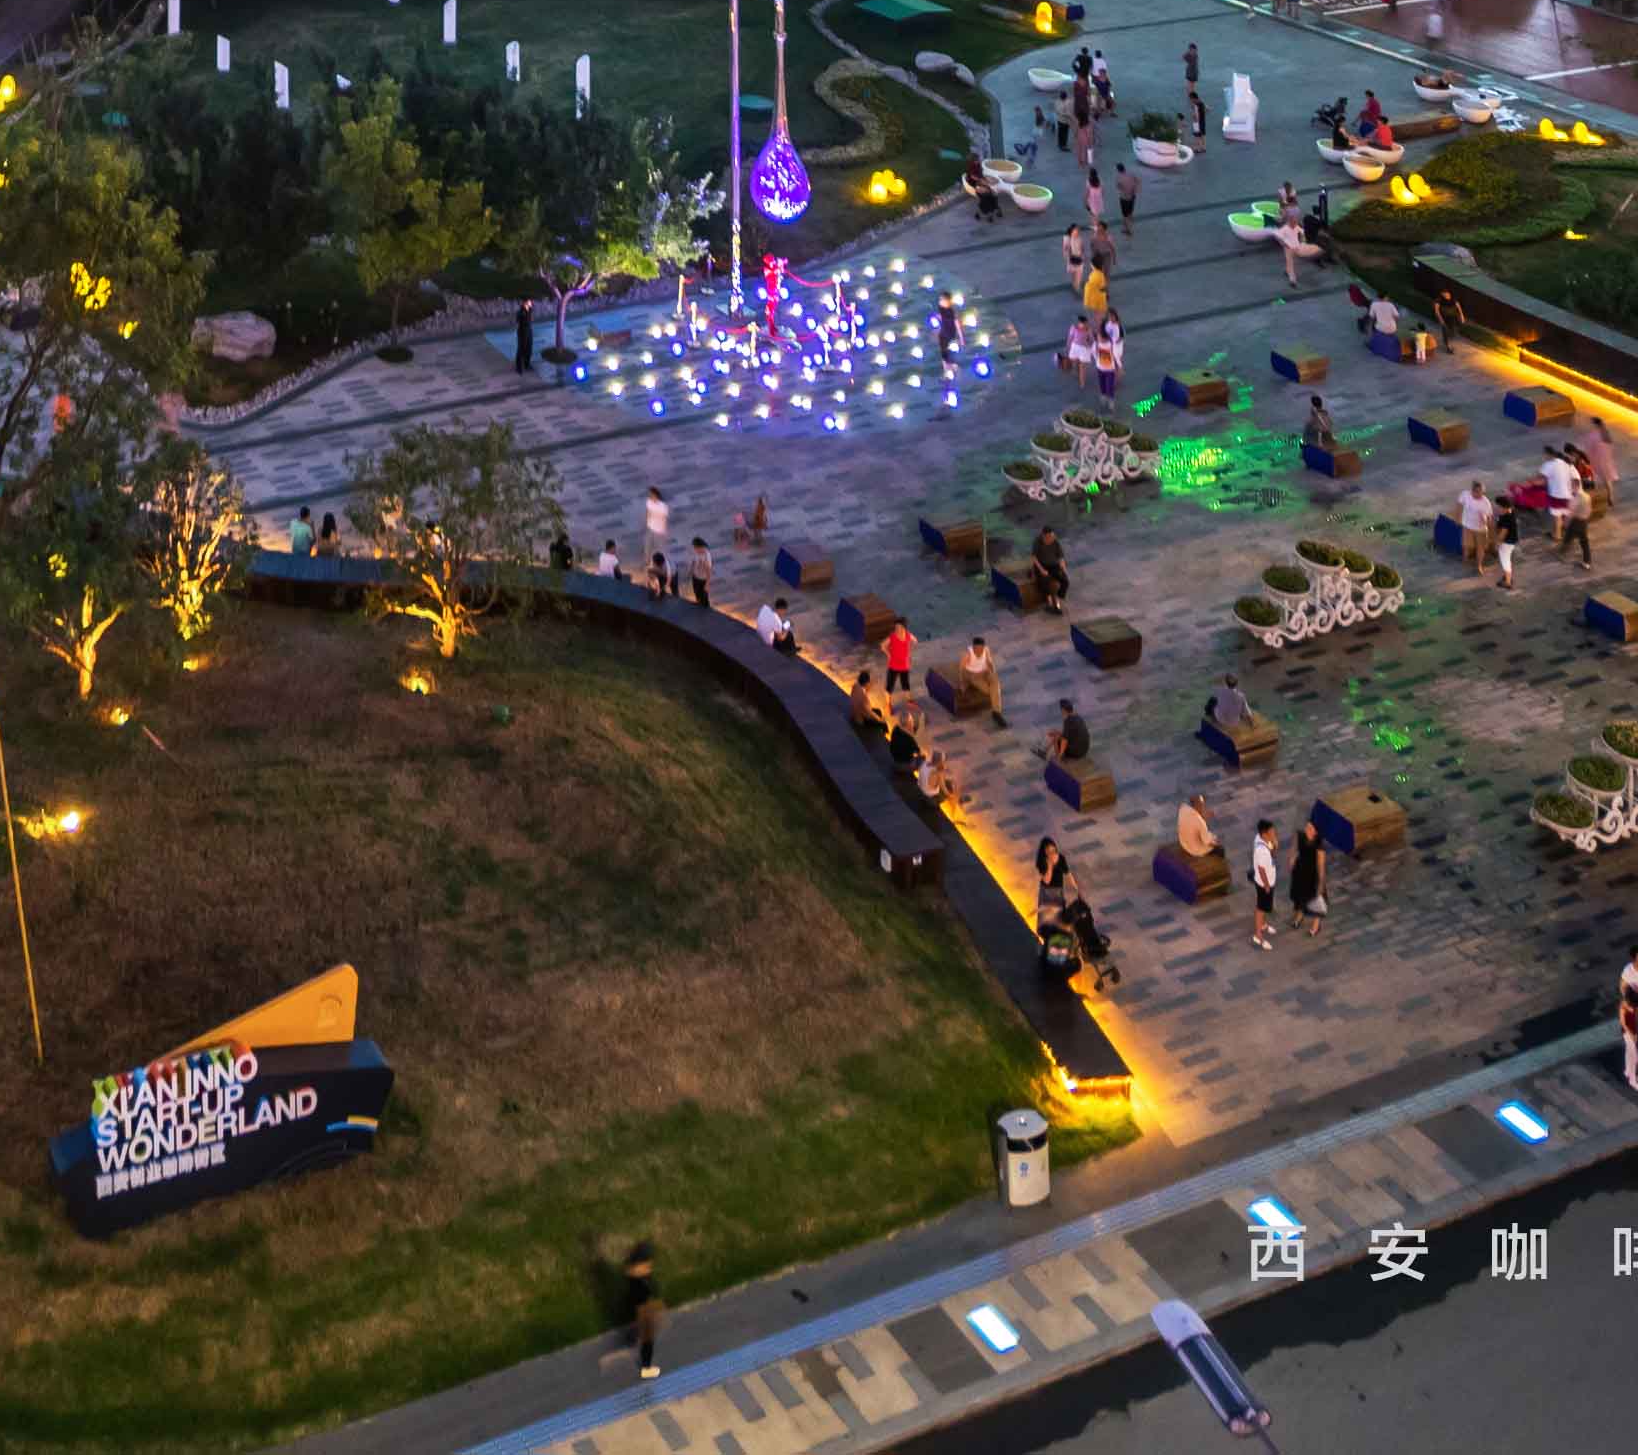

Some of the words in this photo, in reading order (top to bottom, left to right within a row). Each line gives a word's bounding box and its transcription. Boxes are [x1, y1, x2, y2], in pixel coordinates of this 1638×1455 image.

[97, 1082, 245, 1147] START-UP
[99, 1073, 178, 1121] XI'AN
[179, 1051, 259, 1103] INNO
[97, 1086, 319, 1173] WONDERLAND
